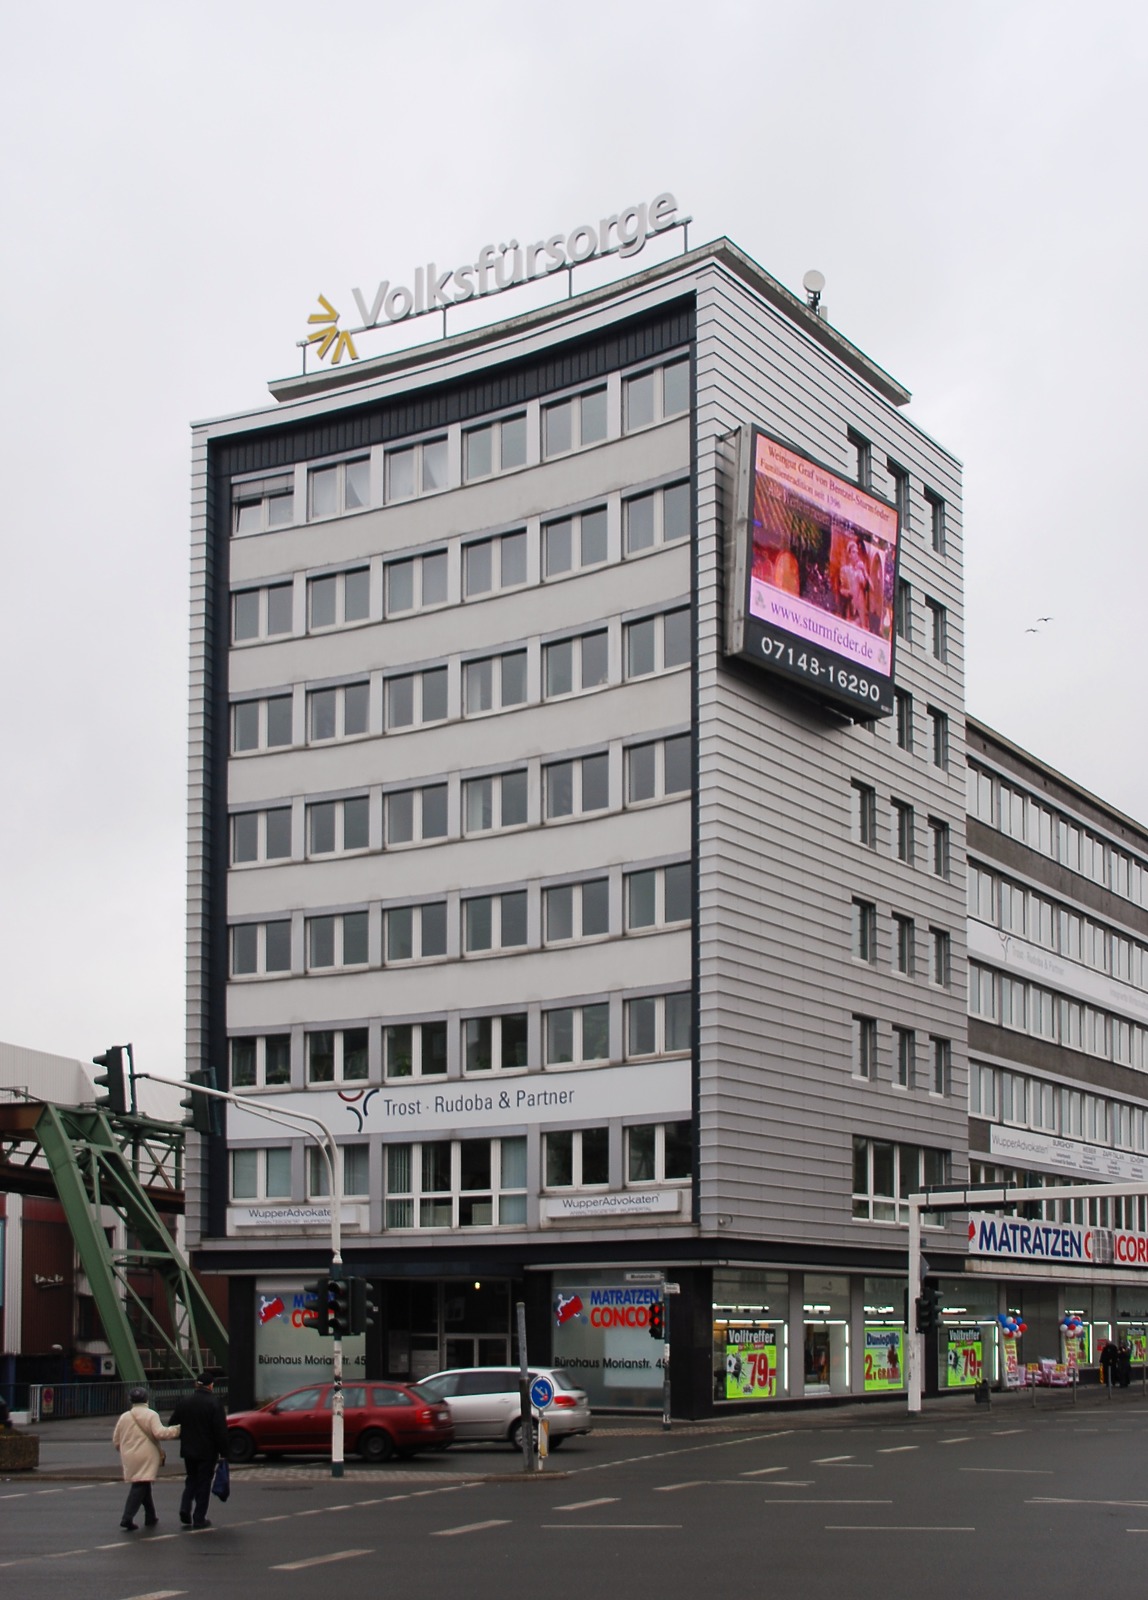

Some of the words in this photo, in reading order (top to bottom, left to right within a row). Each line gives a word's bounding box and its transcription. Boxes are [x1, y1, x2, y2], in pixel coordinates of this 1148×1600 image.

[351, 192, 678, 328] Volksfürsorge
[798, 463, 815, 480] Graf
[770, 602, 873, 659] www.sturmfeder.de
[384, 1099, 421, 1116] Trost
[435, 1094, 493, 1113] Rudoba
[498, 1091, 511, 1109] &
[516, 1089, 575, 1108] Partner
[562, 1195, 659, 1209] WupperAdvokaten
[249, 1208, 331, 1219] WupperAdvokate
[979, 1220, 1082, 1258] MATRATZEN
[1084, 1231, 1148, 1263] CCOR
[590, 1289, 660, 1305] MATRATZEN
[590, 1306, 665, 1328] CONCO
[728, 1329, 774, 1343] Volltreffer
[949, 1329, 980, 1341] Volltreffer
[258, 1355, 302, 1365] Bürohaus
[304, 1355, 351, 1365] Moriatr.
[554, 1357, 599, 1369] Bürohaus
[602, 1358, 652, 1369] Morianstr.
